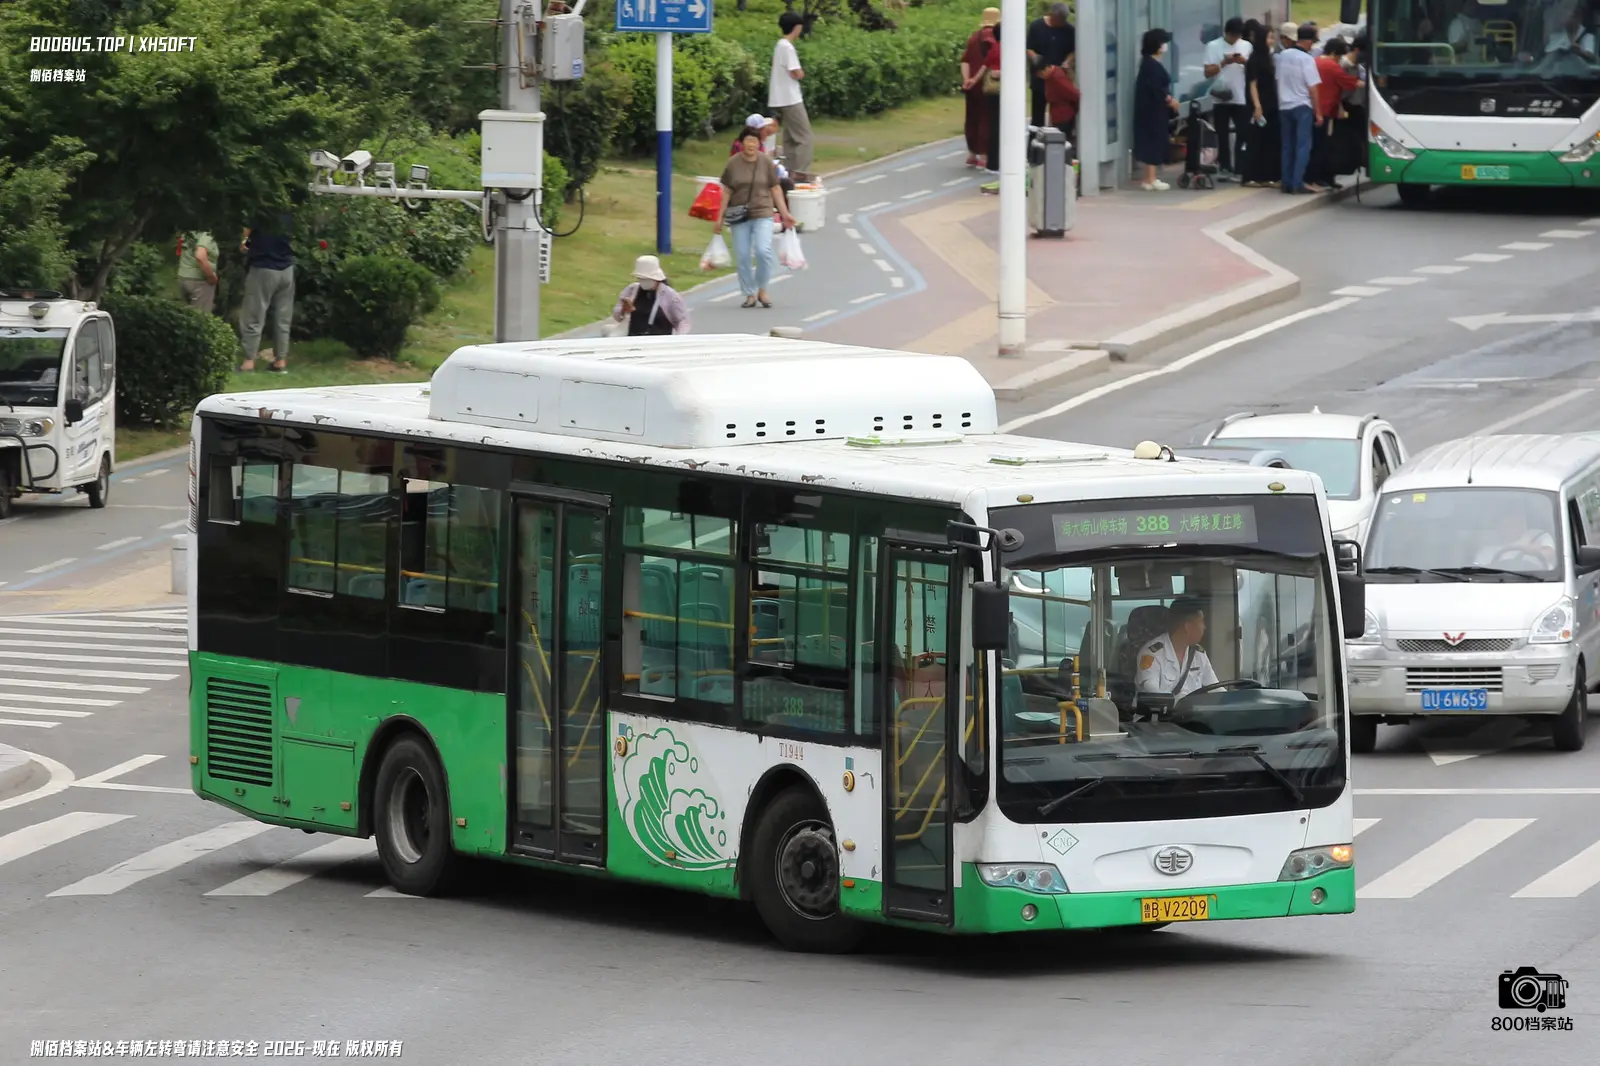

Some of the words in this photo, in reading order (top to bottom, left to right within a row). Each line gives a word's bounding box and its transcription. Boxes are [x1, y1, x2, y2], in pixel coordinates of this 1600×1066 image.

[1135, 515, 1170, 532] 388
[783, 696, 804, 717] 388
[1053, 837, 1073, 848] CNG
